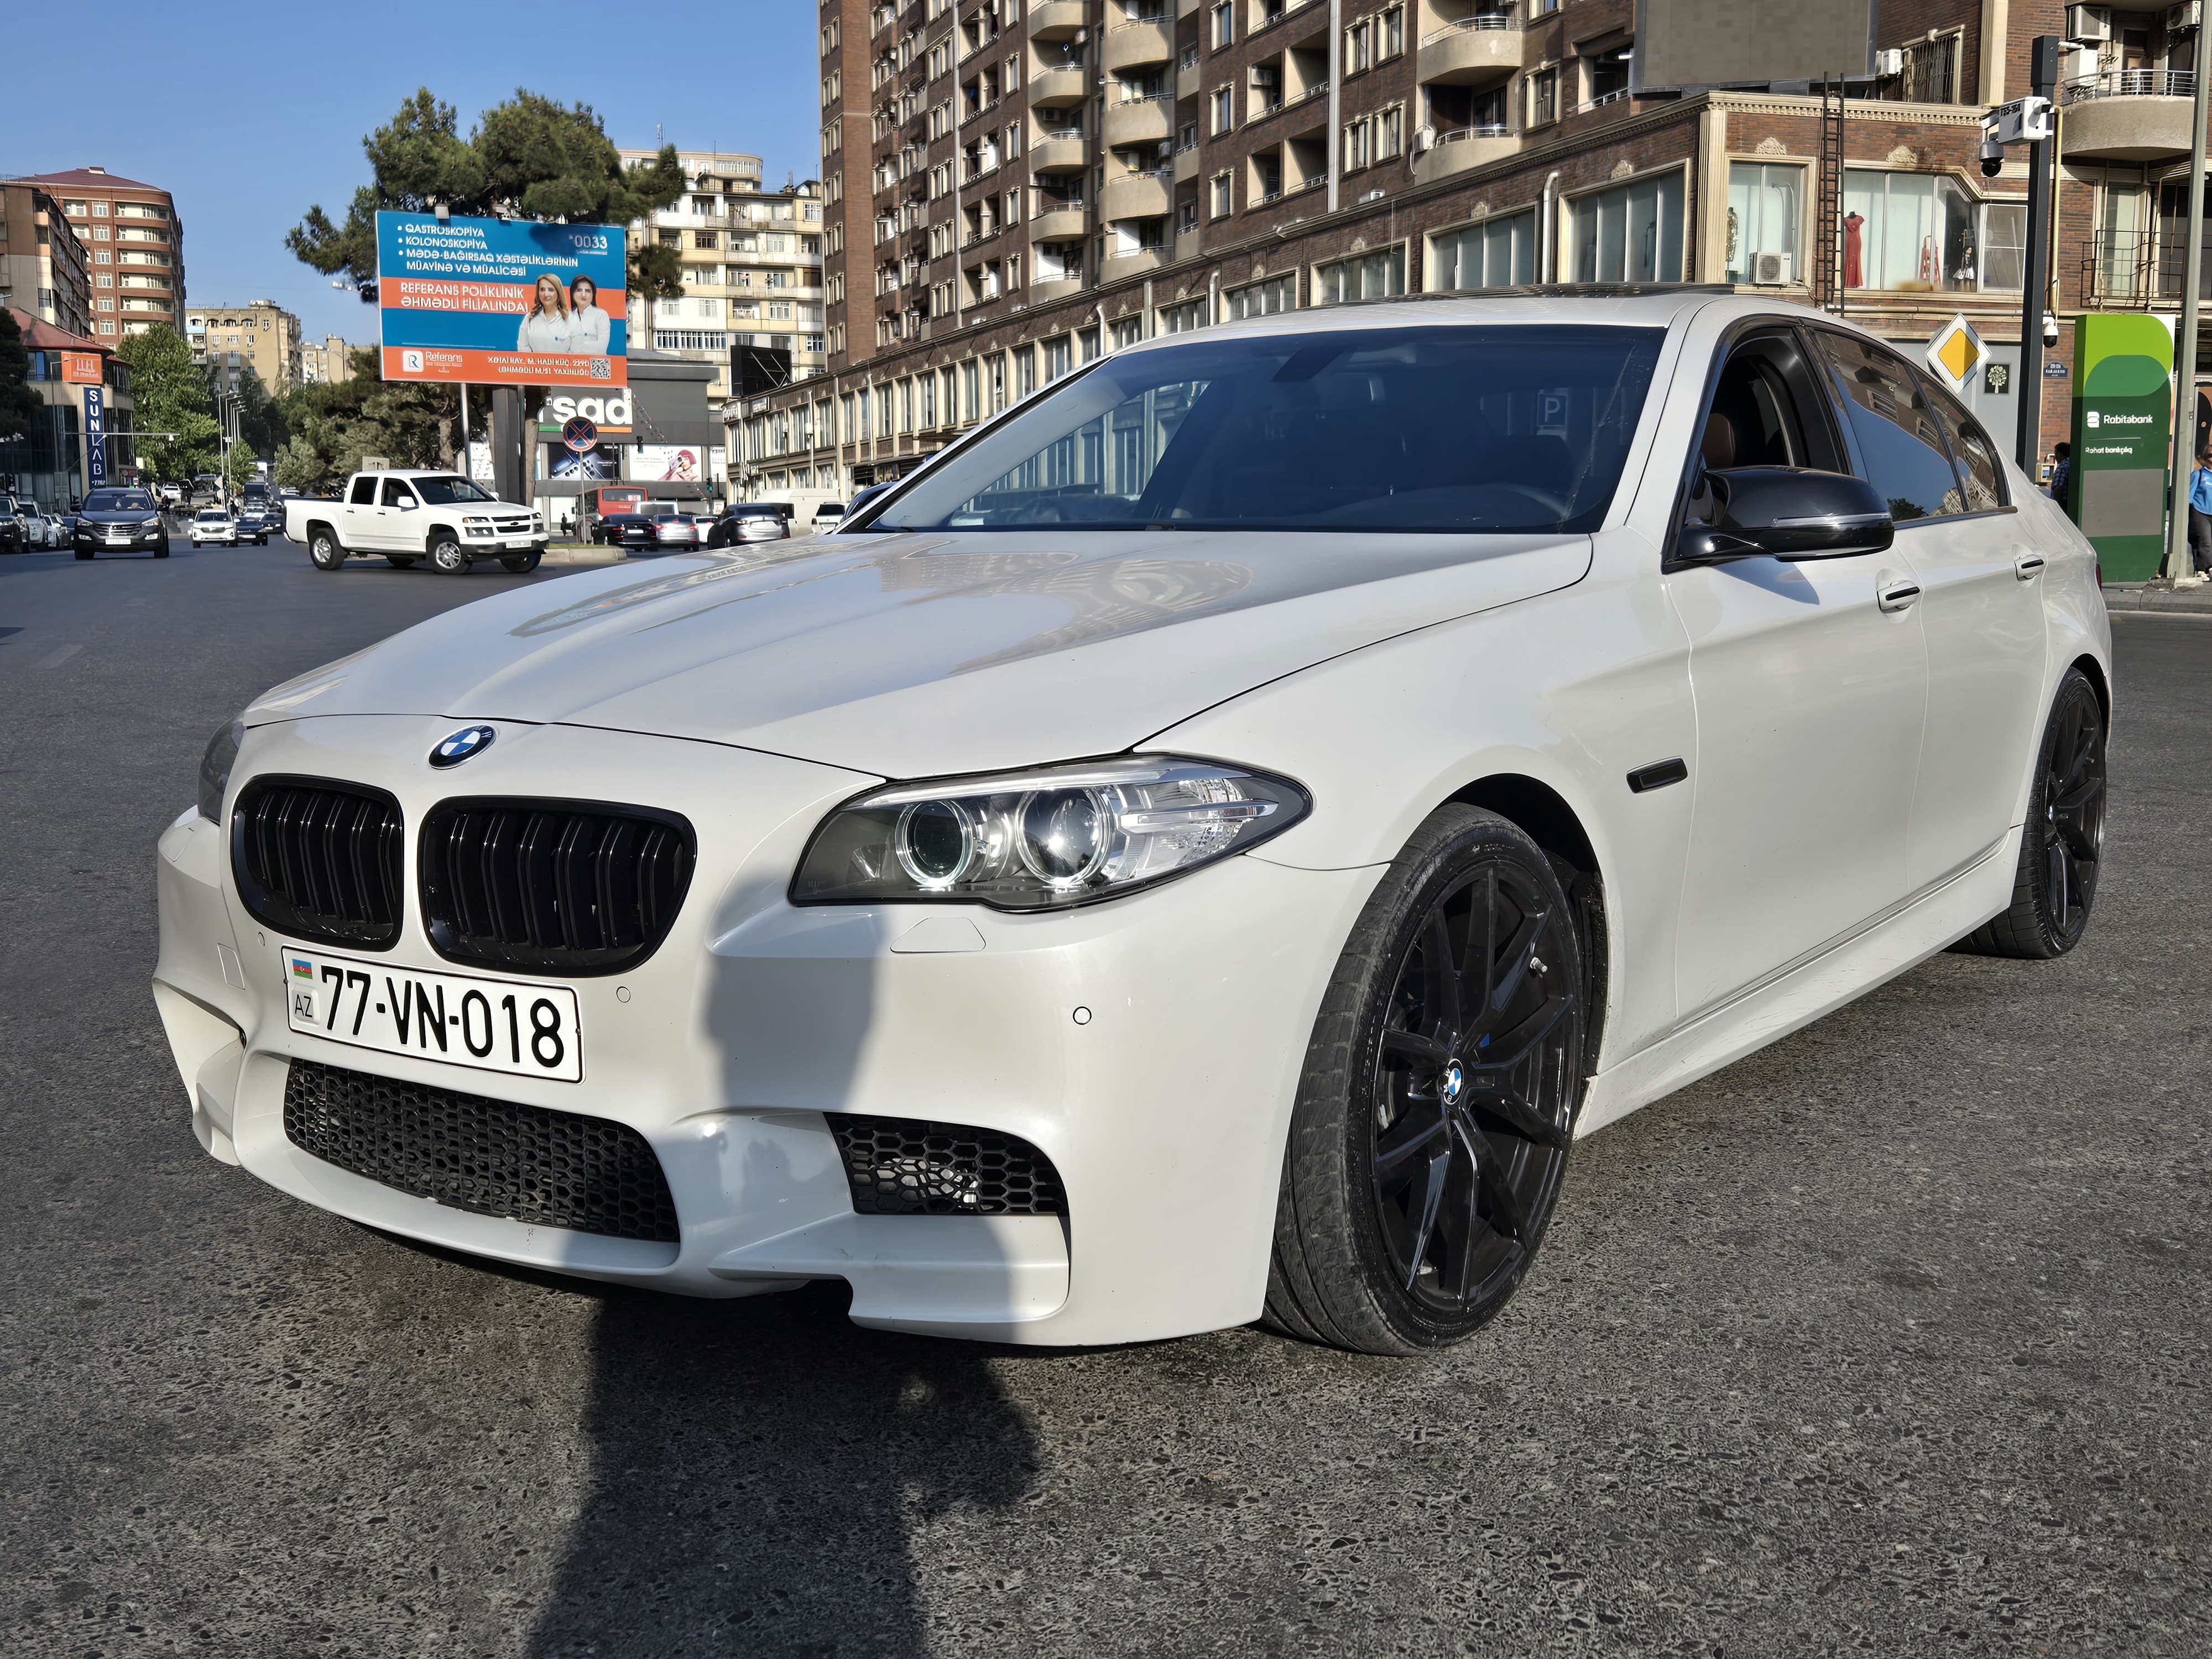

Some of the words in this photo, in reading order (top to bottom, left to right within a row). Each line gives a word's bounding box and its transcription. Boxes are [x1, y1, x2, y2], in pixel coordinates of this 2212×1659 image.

[456, 264, 471, 273] VƏ
[400, 281, 459, 295] REFERANS
[462, 284, 524, 299] POLİKLİNİK
[400, 296, 460, 310] ƏHMƏDLİ
[295, 993, 313, 1018] AZ
[321, 965, 565, 1068] 77-VN-018
